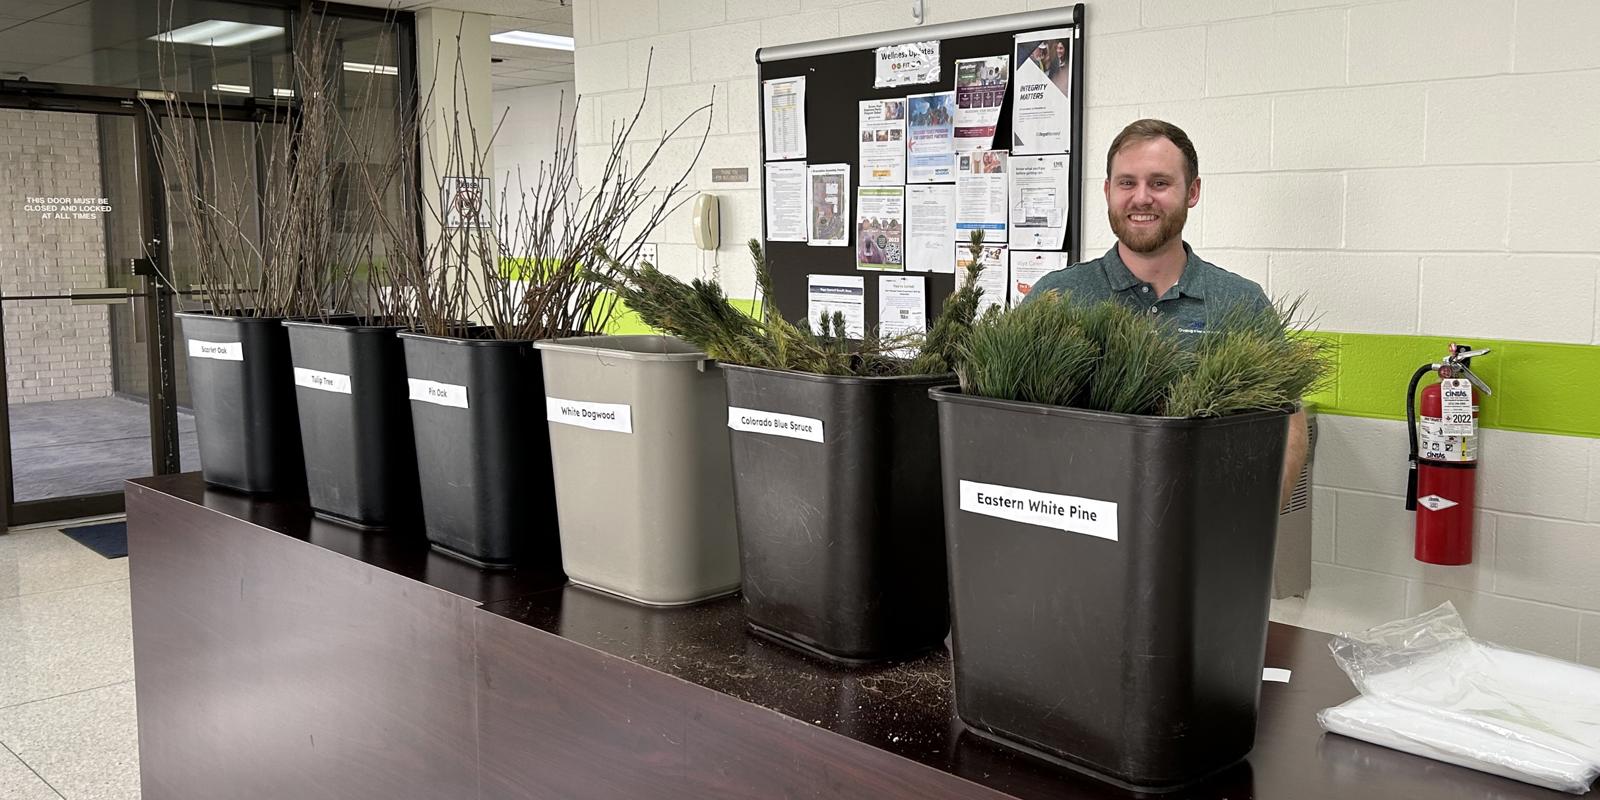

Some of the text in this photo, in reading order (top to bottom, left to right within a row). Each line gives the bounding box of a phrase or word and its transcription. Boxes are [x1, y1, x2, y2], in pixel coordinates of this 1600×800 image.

[1020, 84, 1048, 92] INTEGRITY
[1020, 92, 1044, 100] MATTERS
[312, 375, 334, 386] Tulip Tree
[428, 387, 448, 398] Pin Oak
[561, 406, 615, 420] White Dogwood
[741, 416, 812, 432] Colorado Blue Spruce
[1453, 414, 1472, 424] 2022
[977, 492, 1097, 521] Eastern White Pine
